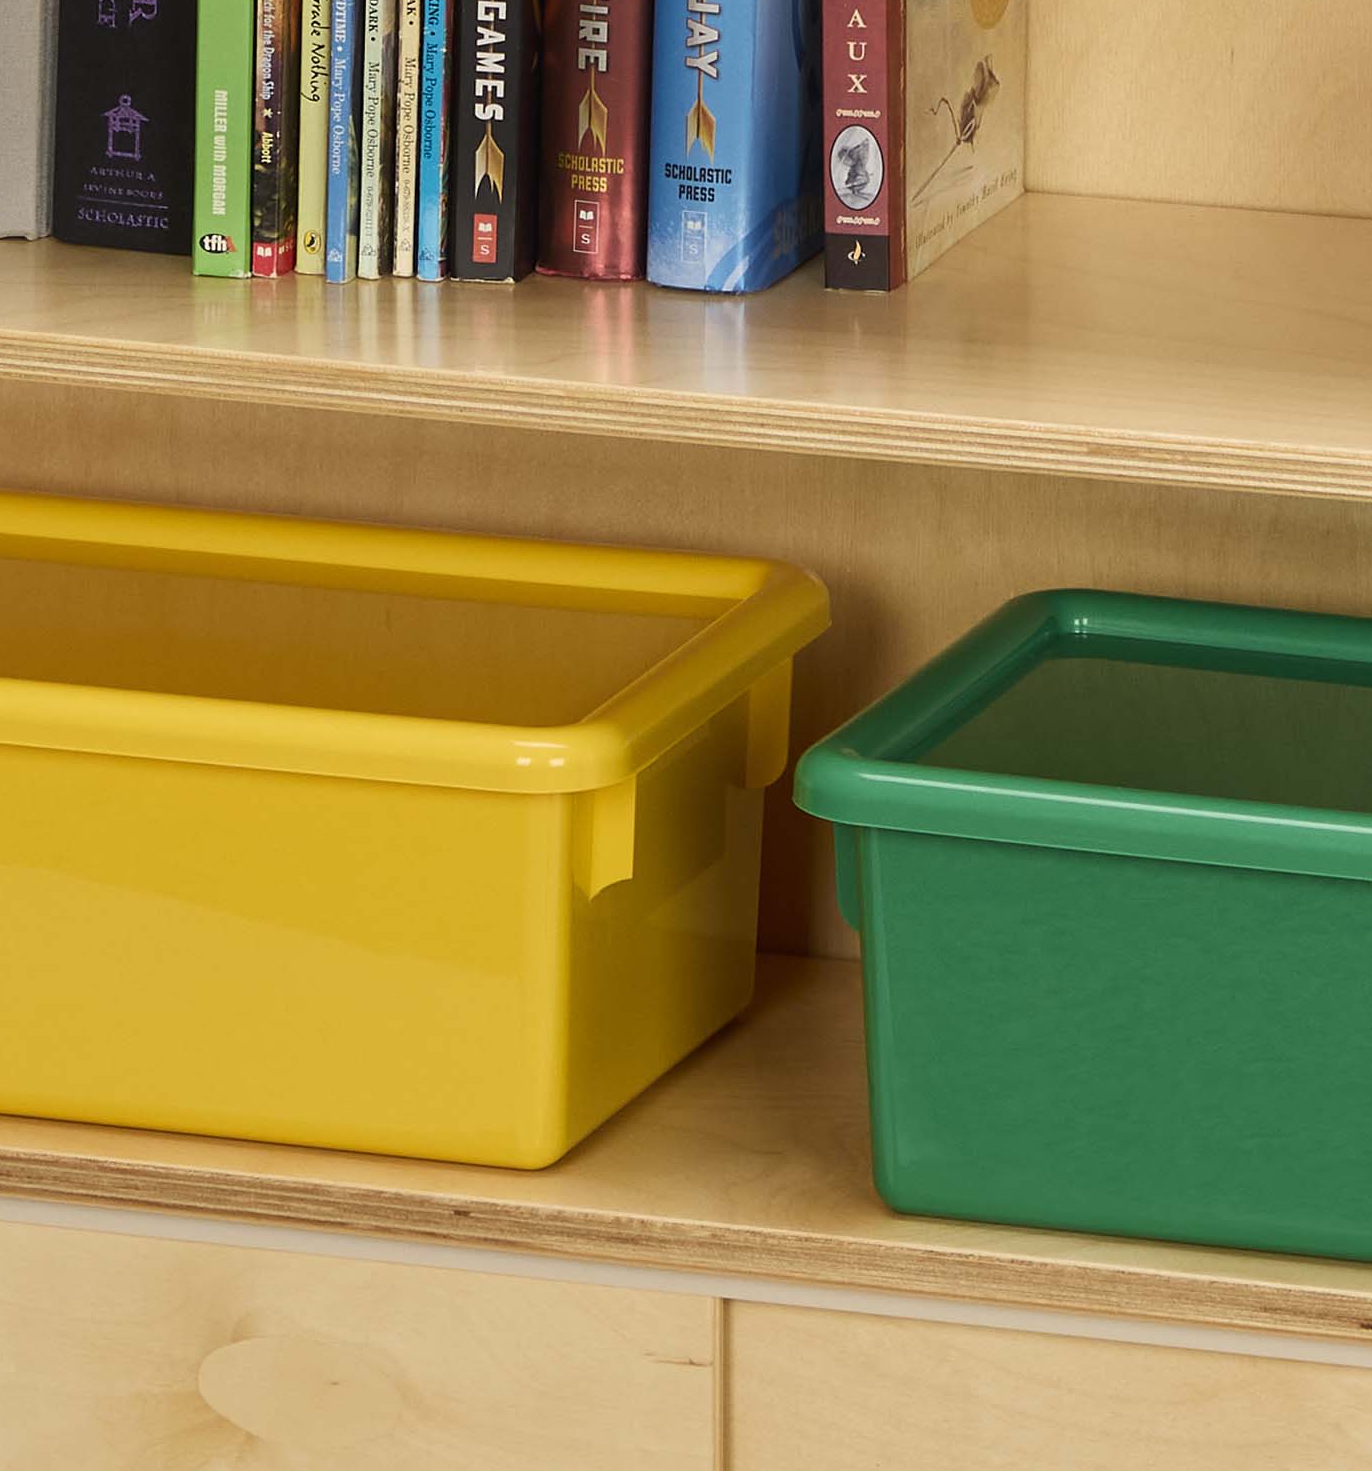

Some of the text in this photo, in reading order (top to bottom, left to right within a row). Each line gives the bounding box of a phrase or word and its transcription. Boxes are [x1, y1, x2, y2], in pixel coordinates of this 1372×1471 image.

[474, 0, 507, 122] GAMES
[299, 42, 329, 103] Nothing
[213, 90, 229, 133] MILLER
[558, 153, 625, 175] SCHOLASTIC
[664, 163, 733, 185] SCHOLASTIC
[212, 165, 228, 215] MORGAN
[570, 172, 608, 193] PRESS
[678, 185, 716, 203] PRESS
[77, 206, 169, 229] SCHOLASTIC
[201, 233, 228, 252] tfh
